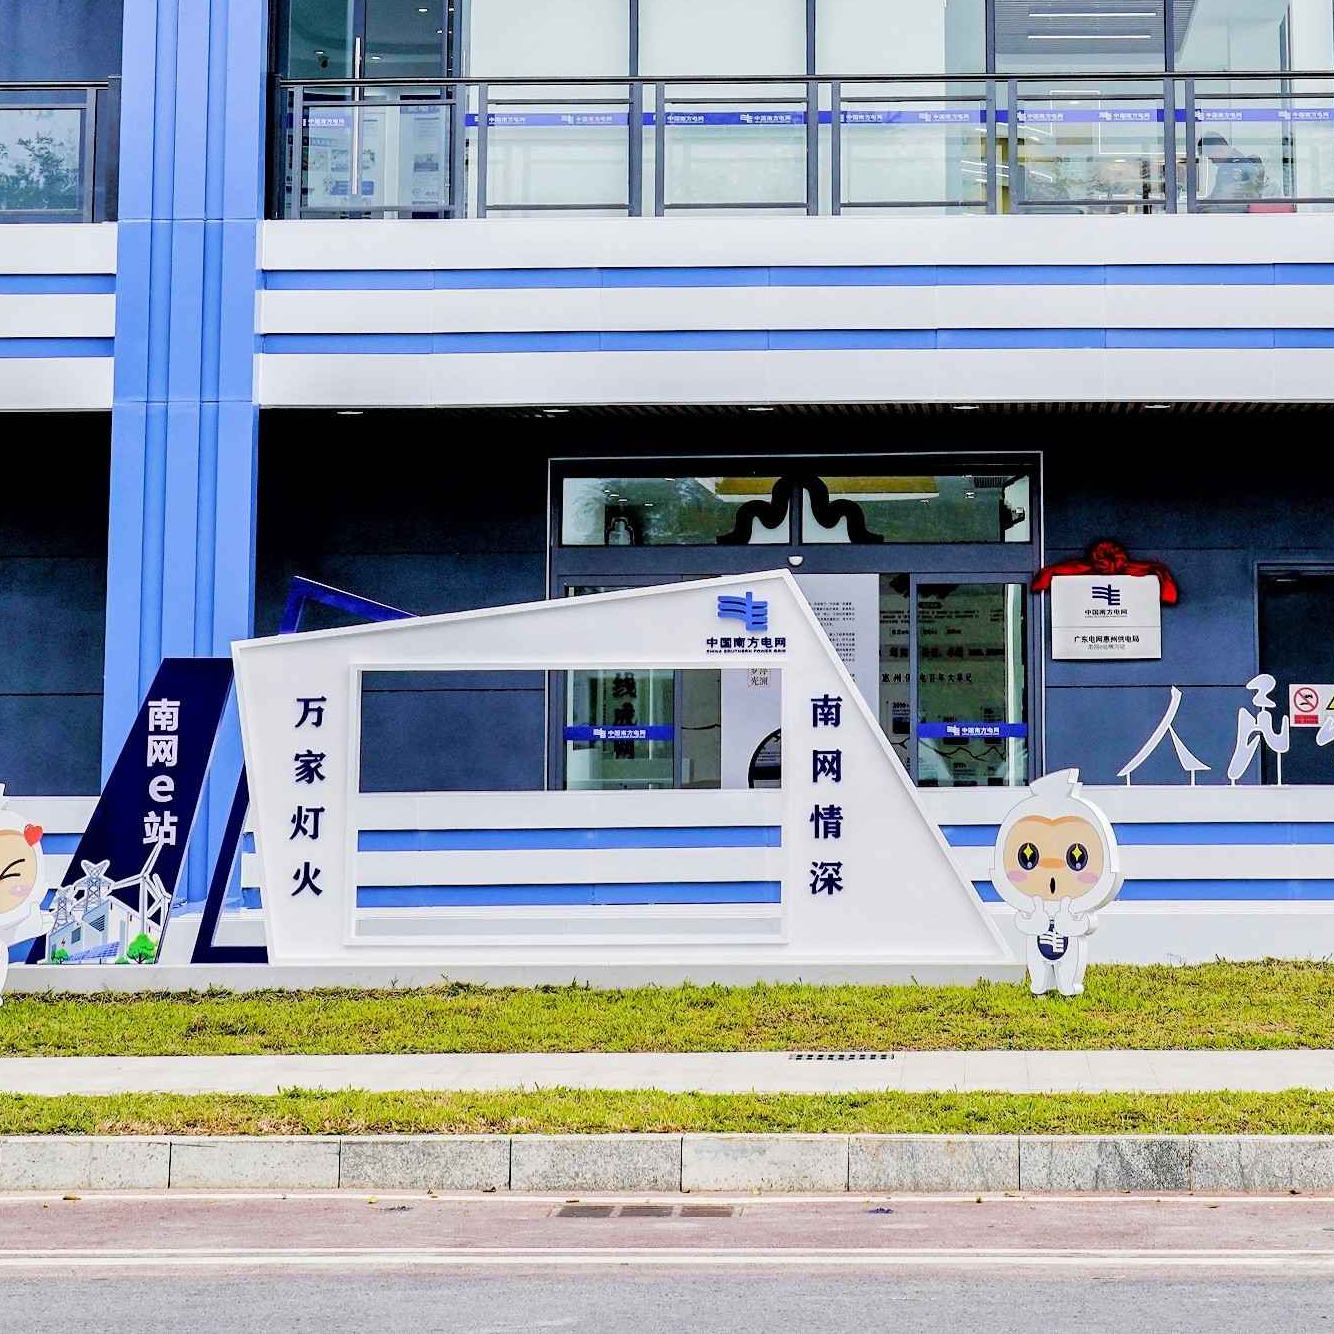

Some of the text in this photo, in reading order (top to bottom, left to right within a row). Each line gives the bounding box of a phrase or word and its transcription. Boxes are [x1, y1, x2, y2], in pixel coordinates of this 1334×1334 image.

[706, 637, 786, 648] 中国南方电网
[143, 698, 180, 846] 南网e站
[289, 695, 328, 898] 万家灯火
[809, 694, 844, 897] 南网情深
